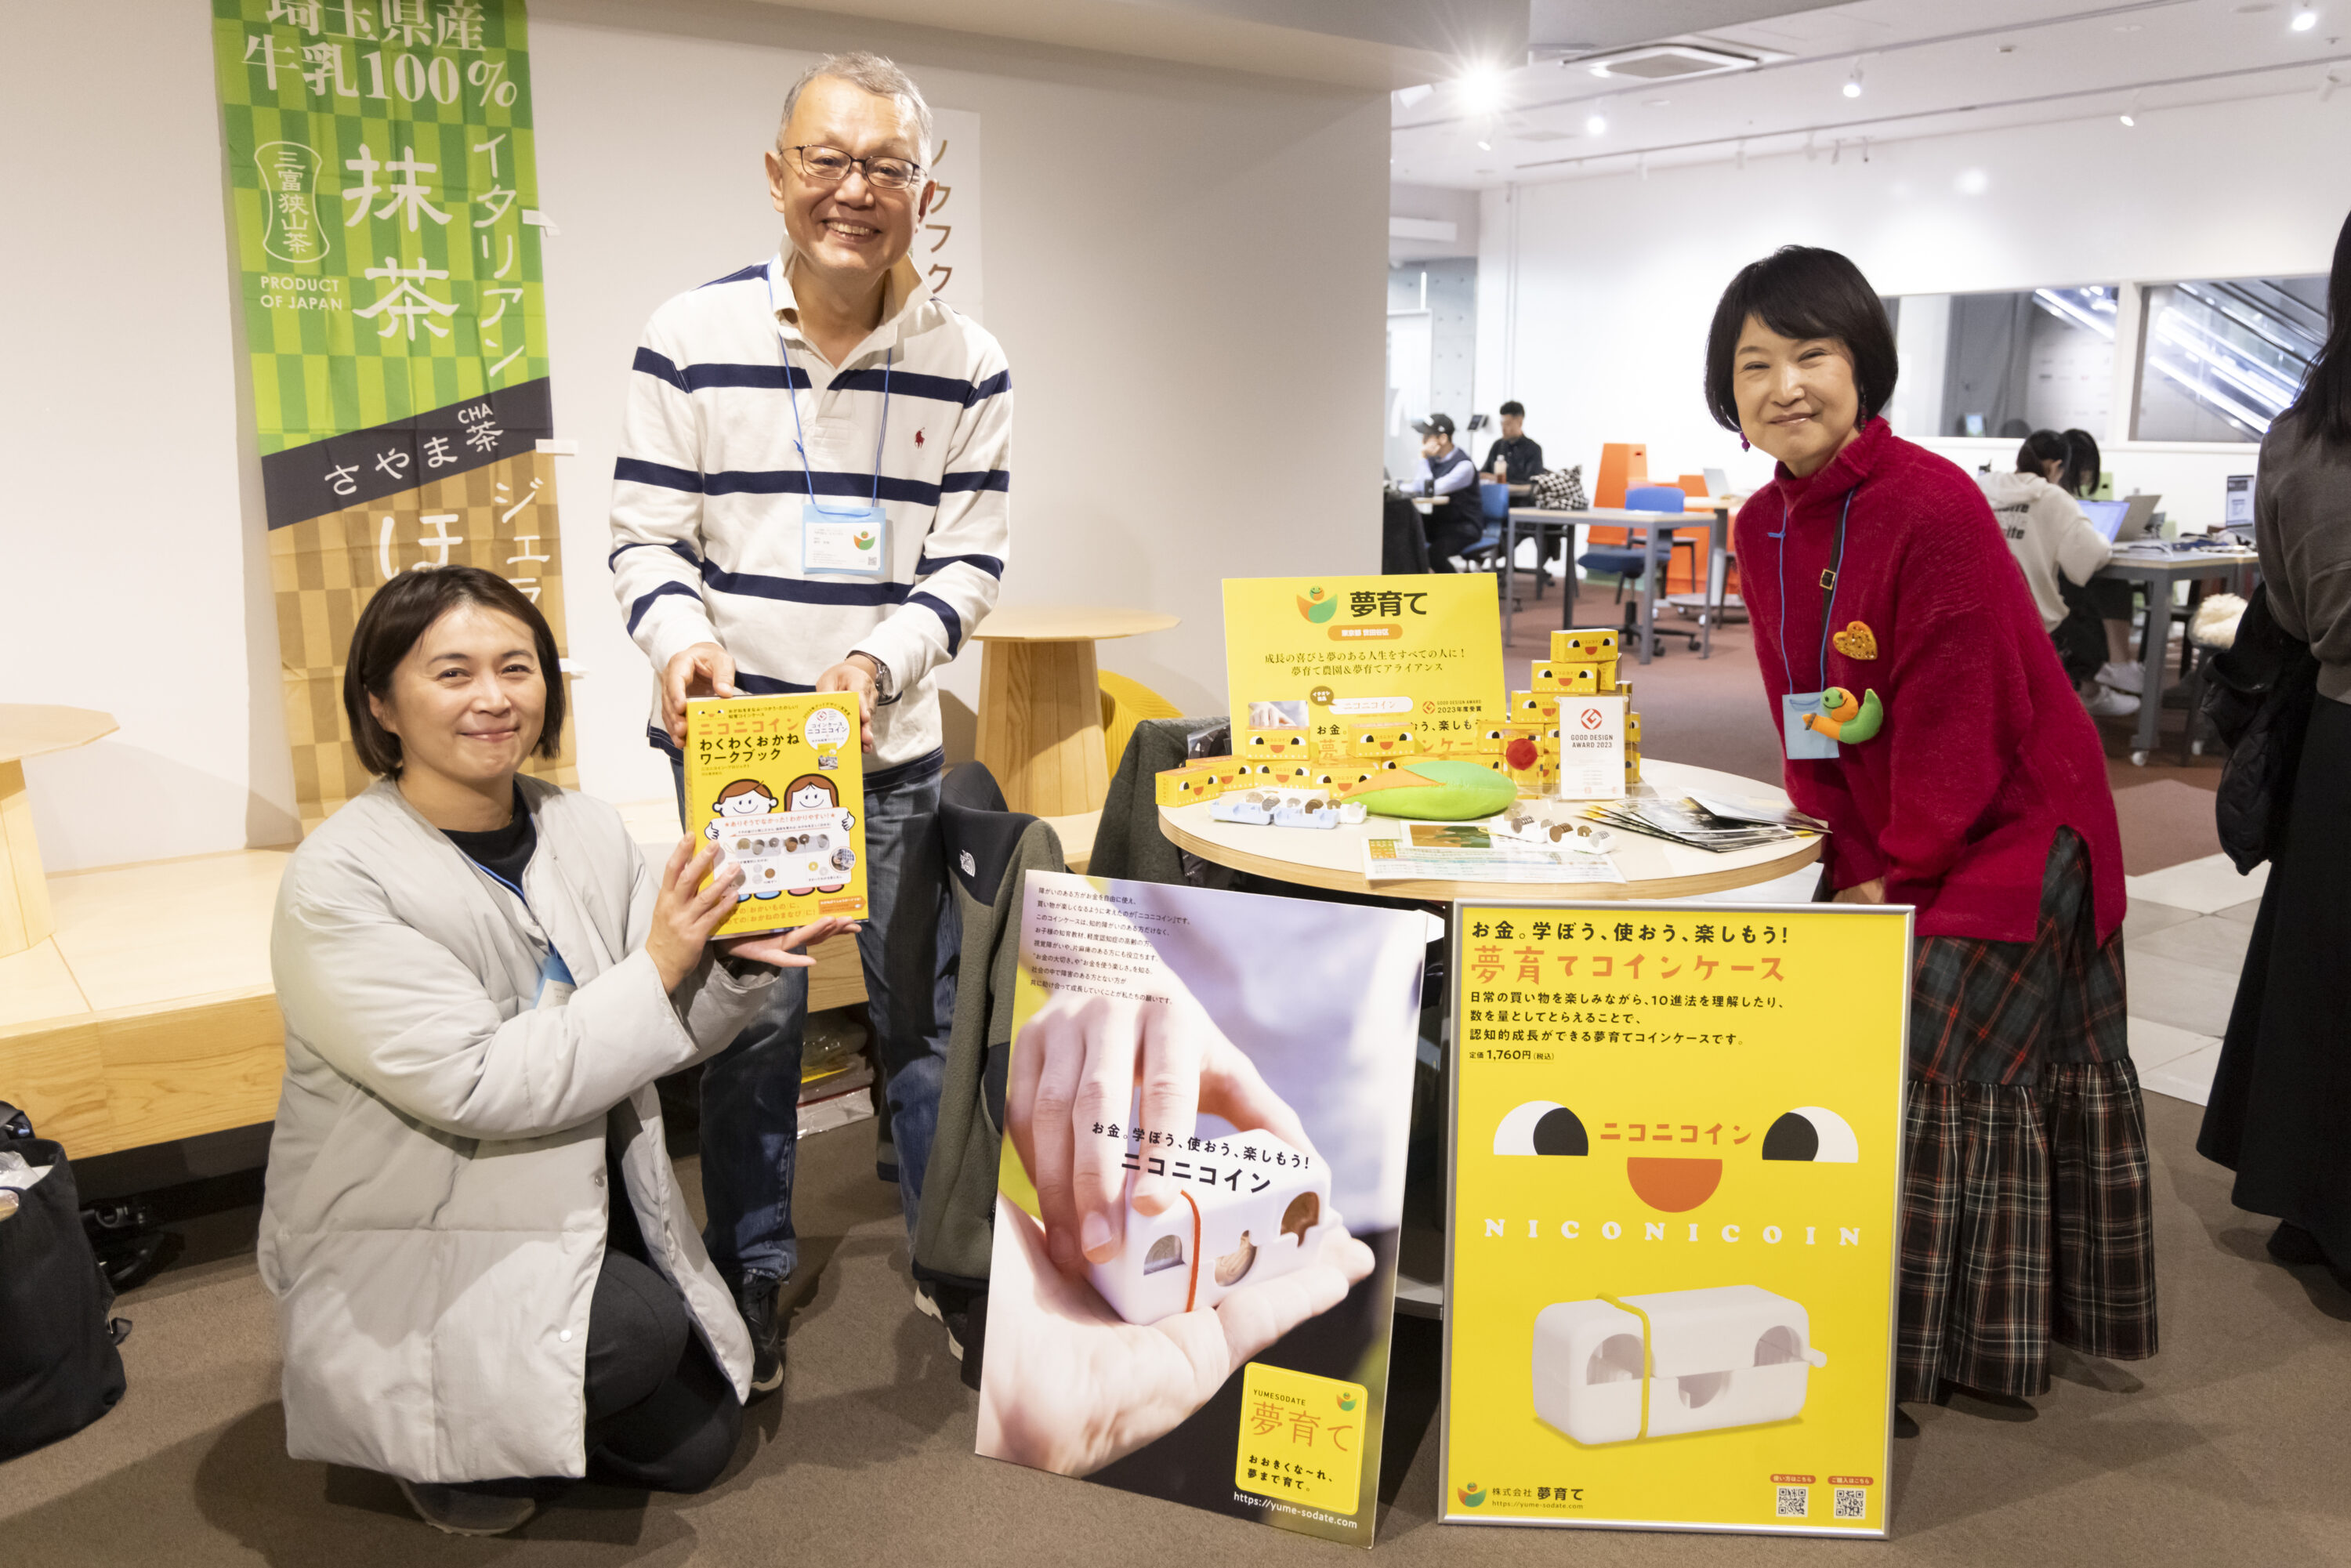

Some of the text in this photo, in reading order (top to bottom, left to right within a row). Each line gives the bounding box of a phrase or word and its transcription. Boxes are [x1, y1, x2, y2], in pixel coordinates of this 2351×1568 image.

[266, 0, 487, 52] 埼玉県産
[241, 34, 517, 107] 牛乳100%
[273, 150, 313, 255] 三富狭山茶
[342, 143, 461, 342] 抹茶
[473, 133, 525, 377] イタリアン
[260, 276, 340, 293] PRODUCT
[260, 295, 342, 311] OF JAPAN
[458, 403, 494, 424] CHA
[324, 421, 504, 496] さやま茶
[1349, 590, 1428, 617] 夢育て
[1291, 662, 1443, 677] 夢育て農園&夢育てアライアンス
[1437, 705, 1482, 714] 2023年度受賞
[699, 718, 799, 736] ニコニコイン
[700, 733, 800, 751] わくわくおかね
[700, 748, 781, 766] ワークブック
[1472, 920, 1788, 945] お金。学ぼう、使おう、楽しもう!
[1471, 944, 1784, 986] 夢育てコインケース
[1471, 990, 1784, 1009] 日常の買い物を楽しみながら、10進法を理解したり、
[1470, 1009, 1641, 1025] 数を量としてとらえることで、
[1469, 1028, 1743, 1046] 認知的成長ができる夢育てコインケースです。
[1486, 1049, 1531, 1062] 1,760円
[1599, 1122, 1752, 1146] ニコニコイン
[1092, 1121, 1310, 1169] お金。学ぼう、使おう、楽しもう!
[1121, 1152, 1271, 1193] ニコニコイン
[1484, 1219, 1860, 1247] NICONICOIN
[1253, 1389, 1306, 1407] YUMESODATE
[1250, 1401, 1354, 1452] 夢育て
[1247, 1468, 1310, 1492] 夢まで育て。
[1773, 1475, 1813, 1483] 使い方はこちら
[1831, 1476, 1871, 1485] ご購入はこちら
[1491, 1487, 1585, 1501] 株式会社 夢育て
[1233, 1491, 1358, 1530] https://yume-sodate.com
[1491, 1500, 1584, 1510] https://yume-sodate.com
